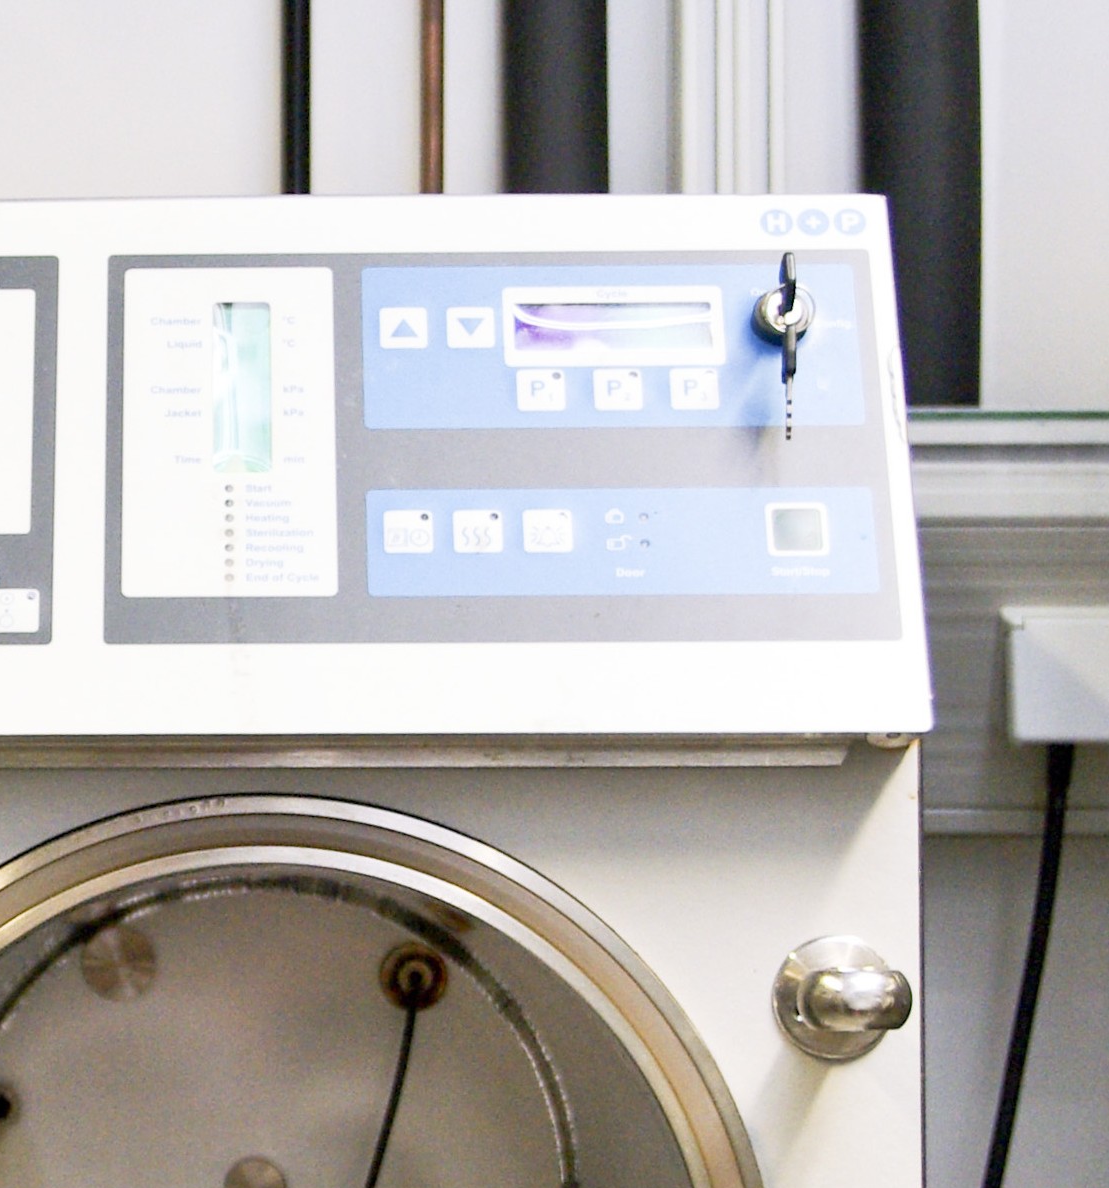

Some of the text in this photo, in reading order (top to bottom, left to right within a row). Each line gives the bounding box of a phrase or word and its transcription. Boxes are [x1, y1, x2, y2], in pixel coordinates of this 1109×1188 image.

[150, 316, 202, 326] Chamber
[166, 340, 203, 350] Liquid
[150, 385, 202, 395] Chamber
[283, 385, 304, 394] kPa
[164, 409, 202, 418] Jacket
[283, 408, 304, 417] kPa
[174, 455, 202, 464] Time
[245, 484, 272, 493] Start
[245, 499, 292, 508] Vacuum
[245, 514, 290, 524] Heating
[245, 529, 314, 538] Sterilization
[245, 543, 304, 553] Recooling
[245, 558, 284, 568] Drying
[616, 567, 645, 577] Door
[245, 573, 269, 582] End
[287, 573, 320, 584] Cycle
